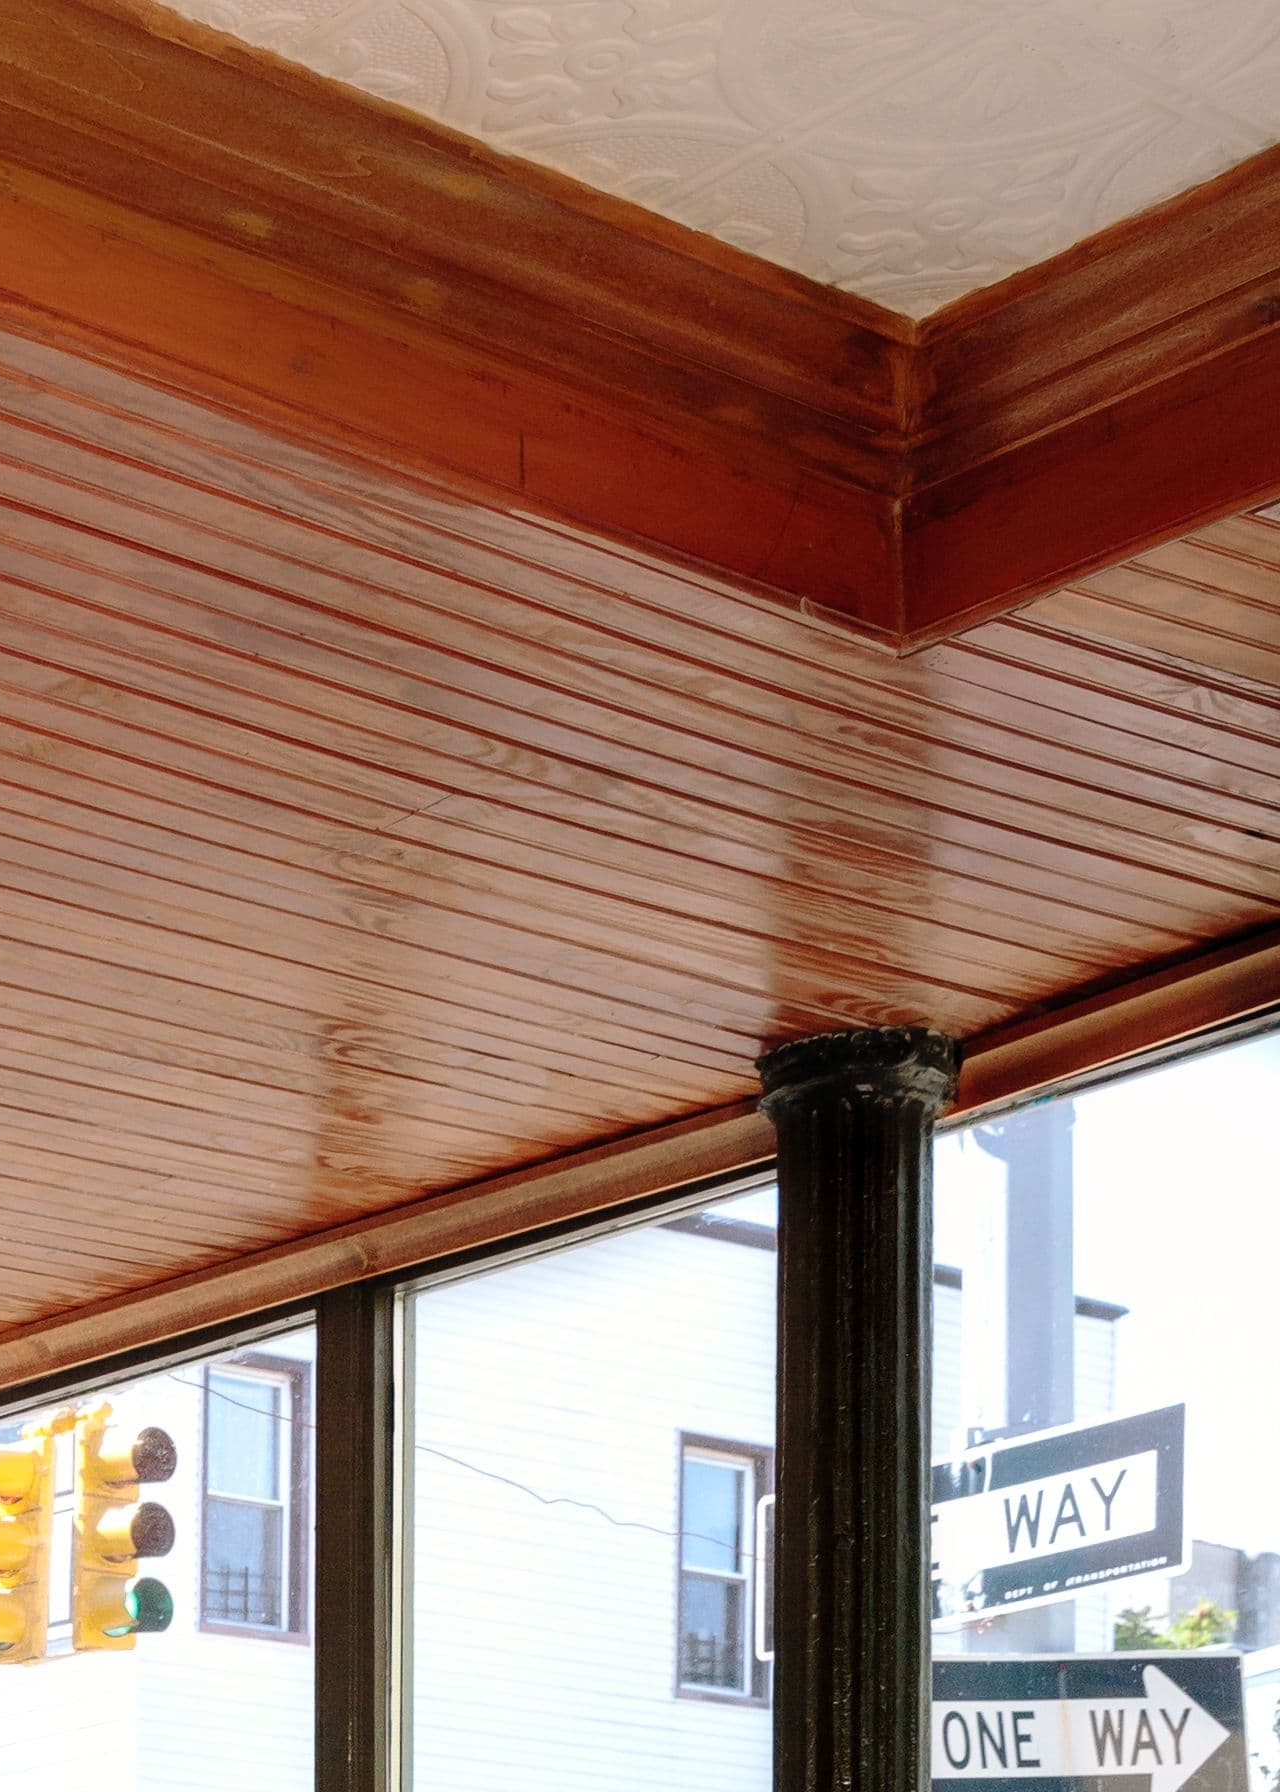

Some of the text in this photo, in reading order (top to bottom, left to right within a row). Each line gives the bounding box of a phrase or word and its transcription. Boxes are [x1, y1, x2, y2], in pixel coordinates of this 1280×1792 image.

[1004, 1469, 1127, 1553] WAY
[1005, 1556, 1168, 1600] DEPT OF TRANSPORTATION
[943, 1708, 1191, 1770] ONE WAY
